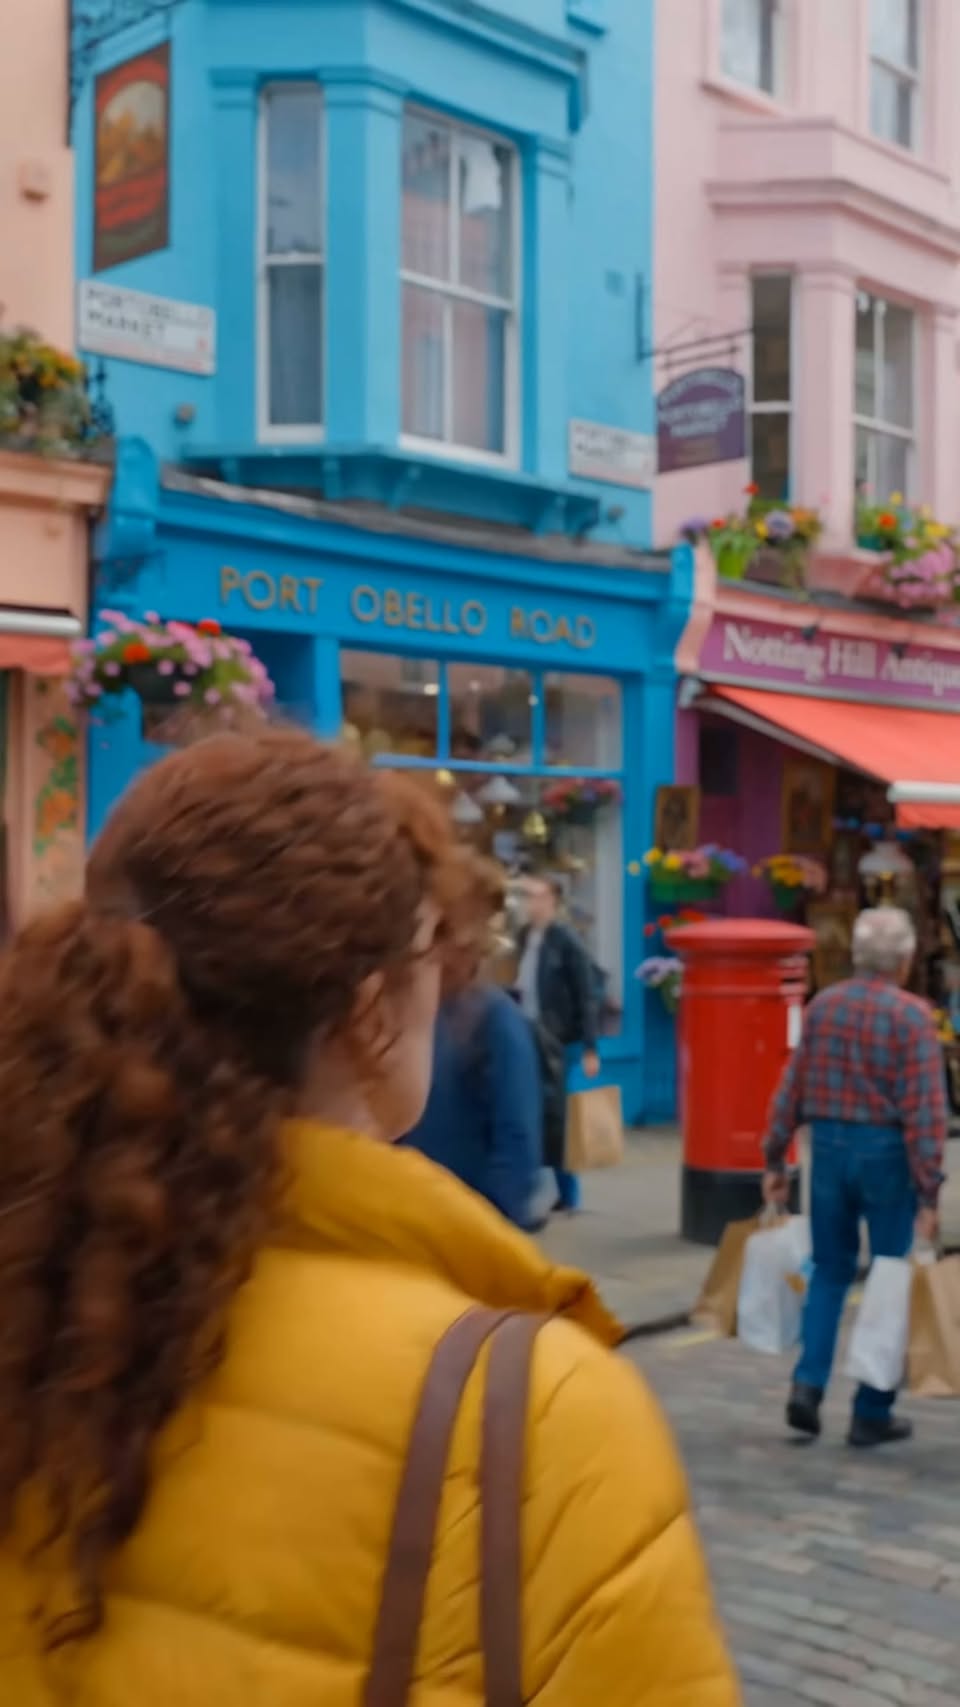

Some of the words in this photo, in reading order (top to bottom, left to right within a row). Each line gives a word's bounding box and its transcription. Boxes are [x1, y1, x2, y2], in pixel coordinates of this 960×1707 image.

[219, 565, 324, 614] PORT
[350, 585, 488, 636] OBELLO
[510, 605, 598, 649] ROAD
[723, 622, 826, 684] Notting
[828, 637, 877, 680] Hill
